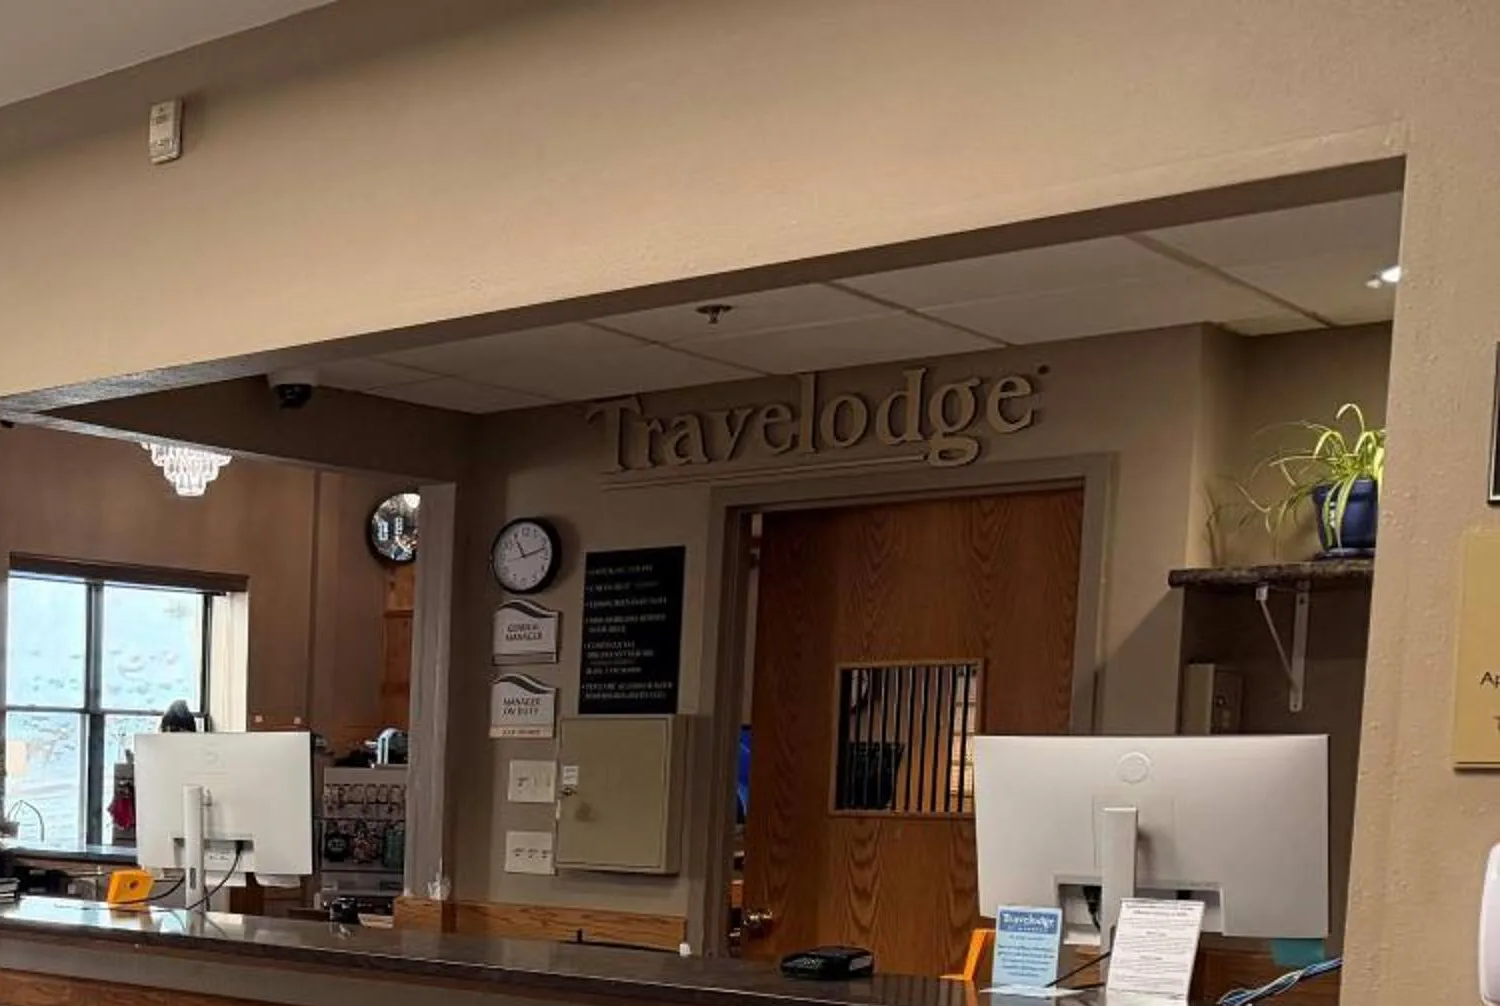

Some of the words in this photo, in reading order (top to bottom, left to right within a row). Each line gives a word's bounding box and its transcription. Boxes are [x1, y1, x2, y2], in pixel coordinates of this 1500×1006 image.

[585, 367, 1036, 466] Travelodge
[505, 631, 543, 641] MANAGER
[503, 697, 541, 706] MANAGER
